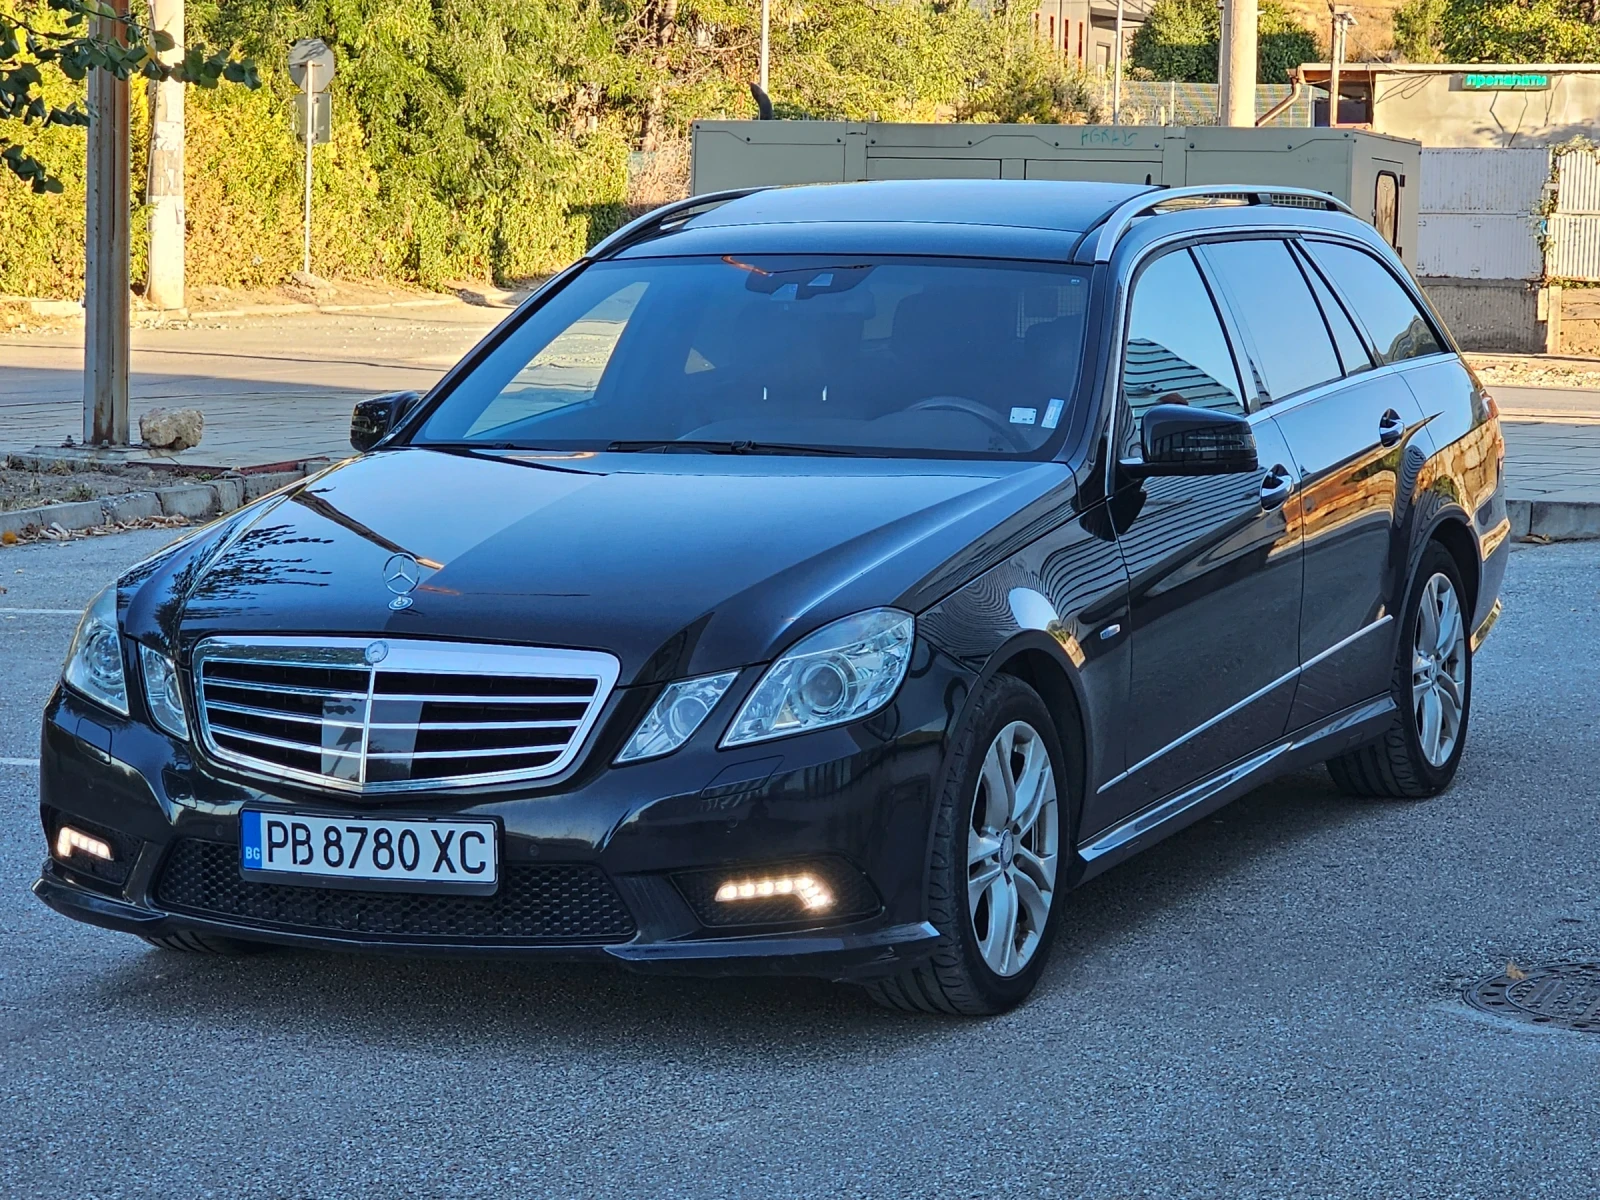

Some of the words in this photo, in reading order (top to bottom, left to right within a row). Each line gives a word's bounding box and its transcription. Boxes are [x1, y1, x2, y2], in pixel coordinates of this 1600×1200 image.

[245, 846, 261, 860] BG
[267, 820, 314, 865] PB
[323, 825, 420, 872] 8780
[431, 829, 487, 874] XC
